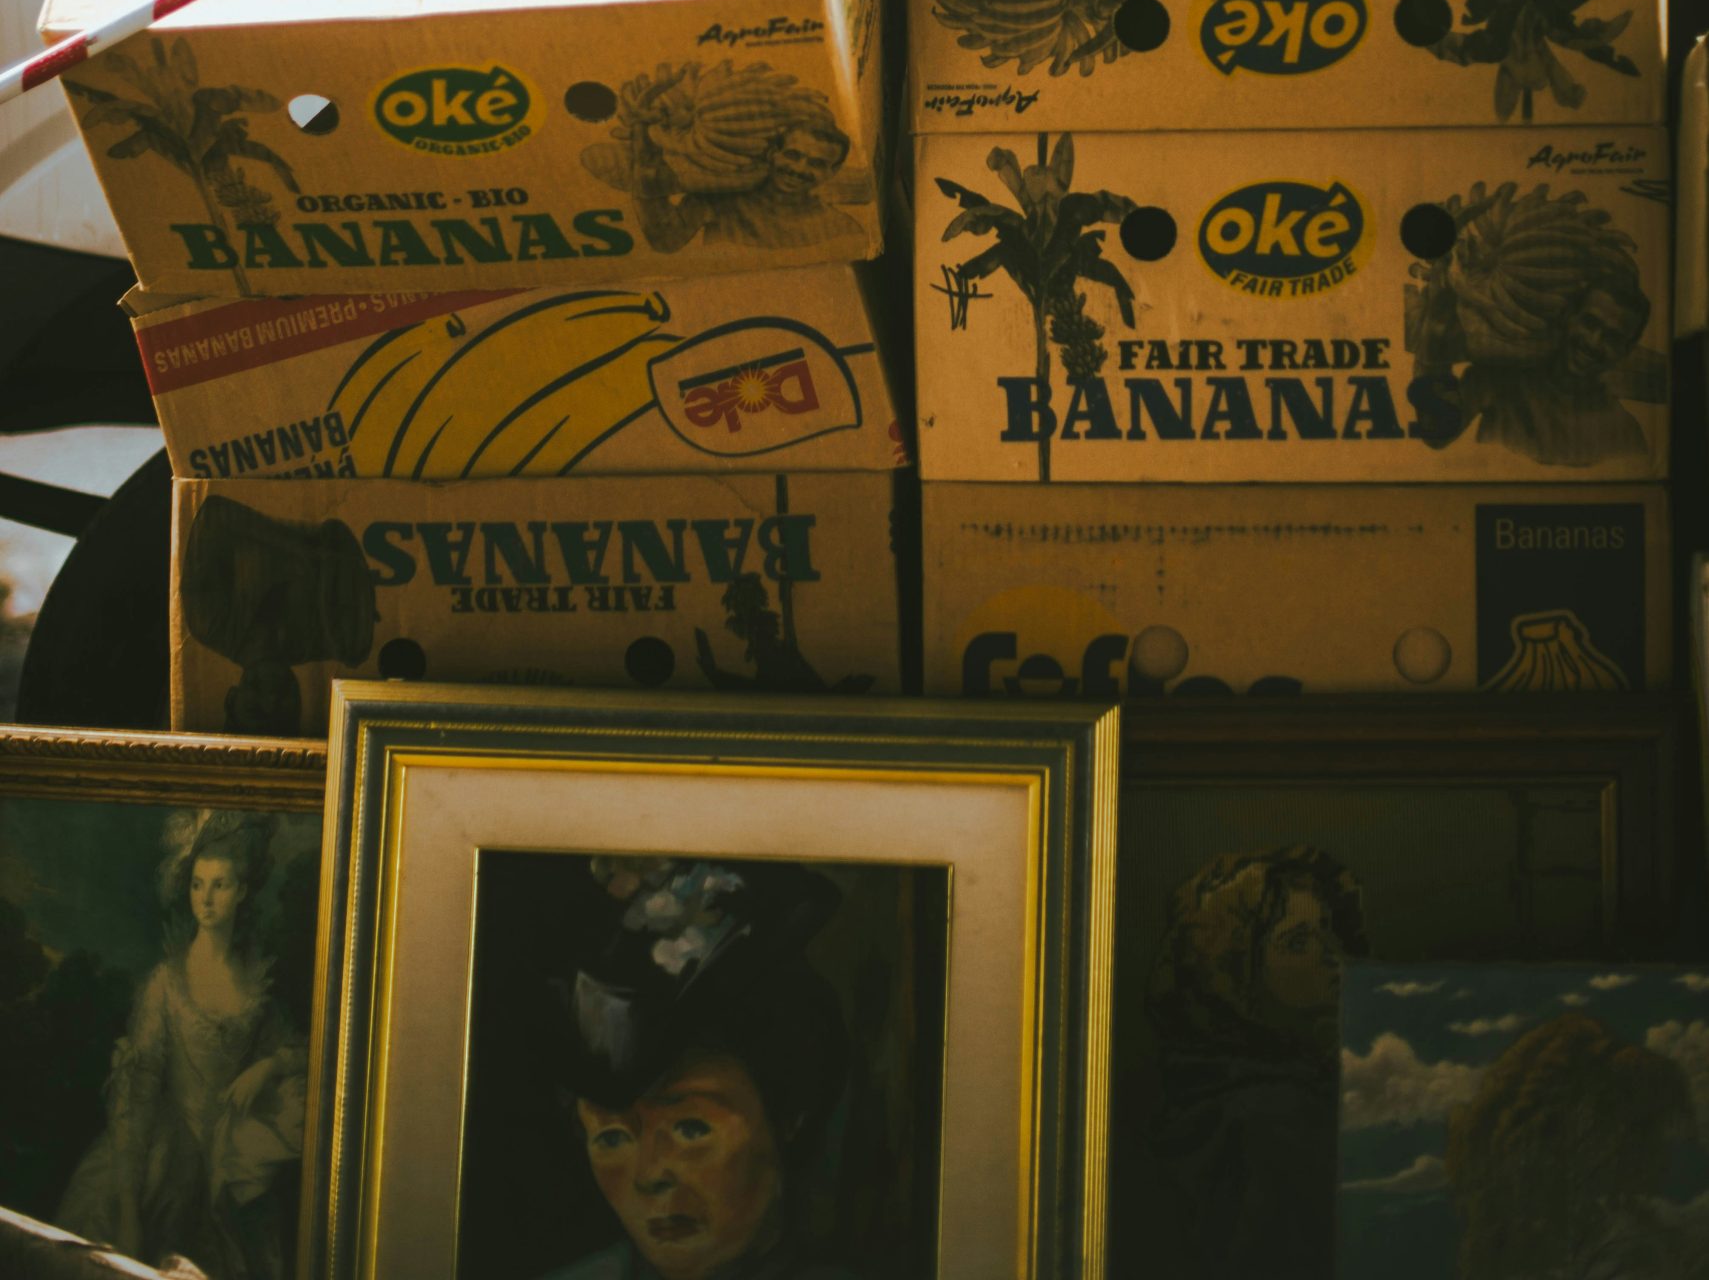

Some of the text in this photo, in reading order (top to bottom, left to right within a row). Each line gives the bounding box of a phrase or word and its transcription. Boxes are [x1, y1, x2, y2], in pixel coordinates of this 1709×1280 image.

[698, 16, 825, 46] AgroFair
[382, 74, 519, 130] oké
[924, 83, 1041, 117] AgroFair
[1526, 142, 1647, 172] AgroFair
[296, 193, 447, 214] ORGANIC
[471, 187, 529, 209] BIO
[170, 209, 635, 271] BANANAS
[1206, 193, 1350, 259] oké
[1230, 257, 1359, 298] FAIR TRADE
[256, 301, 359, 346] PREMIUM
[154, 329, 250, 373] BANANAS
[1118, 338, 1390, 370] FAIR TRADE
[684, 360, 820, 434] Dole
[997, 374, 1463, 442] BANANAS
[189, 411, 349, 479] BANANAS
[363, 514, 821, 586] BANANAS
[1495, 518, 1625, 550] Bananas
[451, 585, 676, 613] FAIR TRADE
